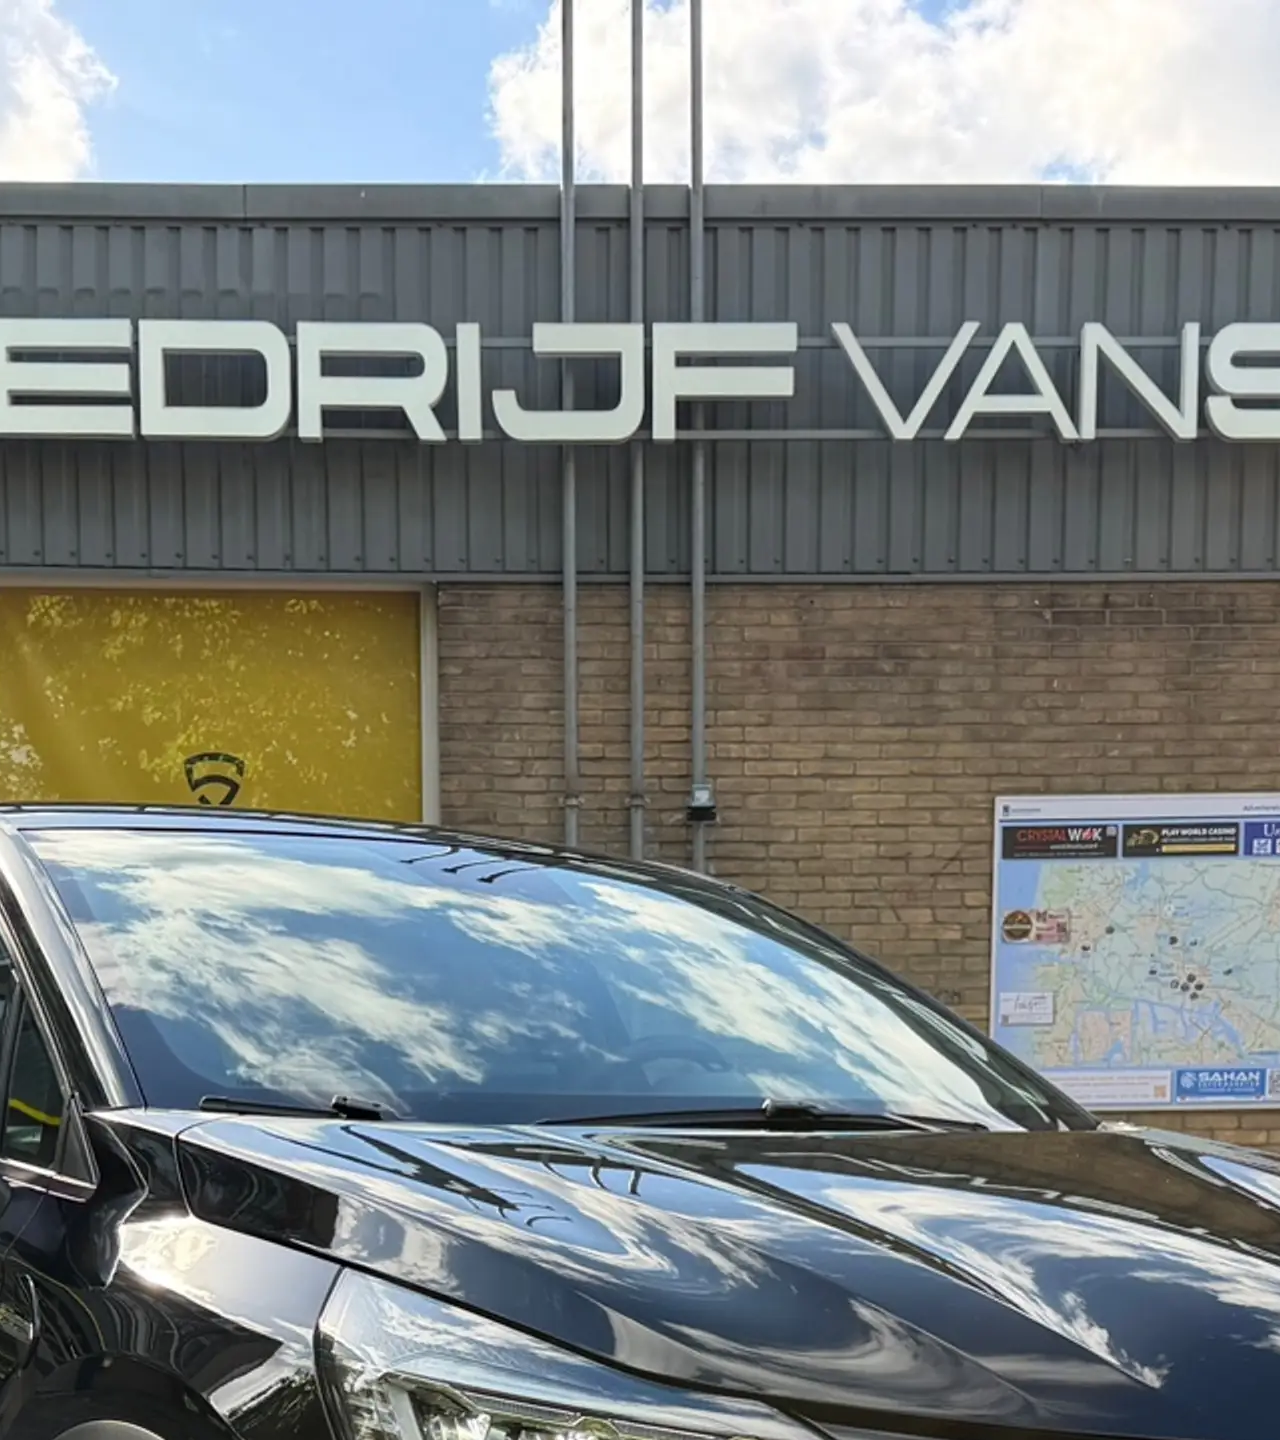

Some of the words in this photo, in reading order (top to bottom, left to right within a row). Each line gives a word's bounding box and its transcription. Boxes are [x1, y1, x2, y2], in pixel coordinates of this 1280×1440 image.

[1161, 828, 1180, 837] PLAY
[1180, 827, 1207, 836] WORLD
[1208, 827, 1237, 836] CASINO
[1198, 1071, 1261, 1082] SAHAN
